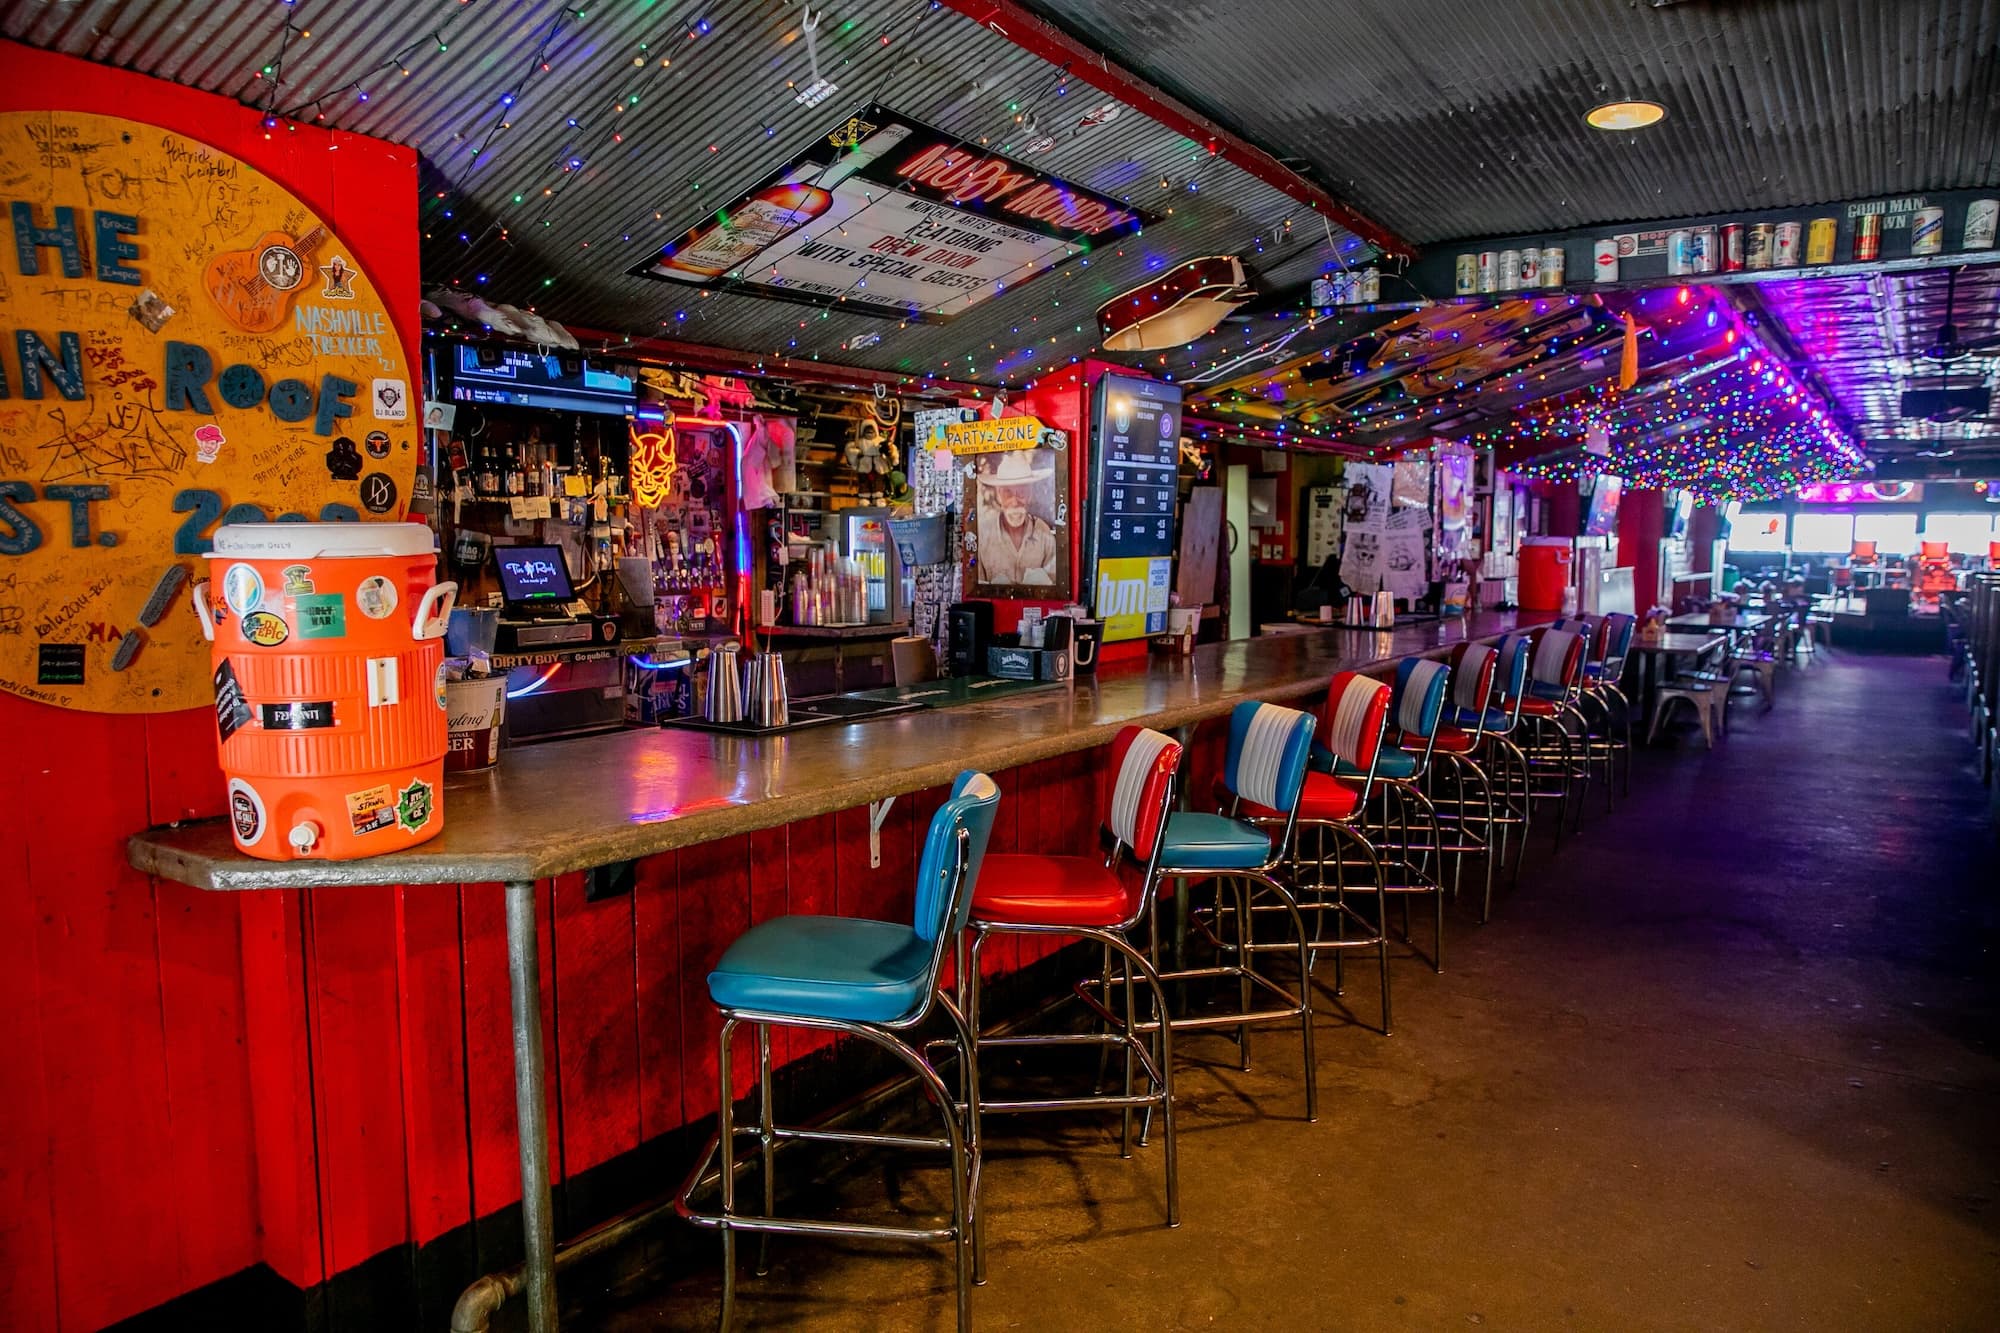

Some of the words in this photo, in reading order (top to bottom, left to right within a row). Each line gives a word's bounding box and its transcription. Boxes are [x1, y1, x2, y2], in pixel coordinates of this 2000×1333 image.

[1003, 182, 1138, 236] MONDAY
[1847, 202, 1886, 218] GOOD
[1889, 197, 1924, 214] MAN
[904, 199, 958, 221] MONTHLY
[955, 214, 998, 231] ARTIST
[991, 225, 1046, 245] SHOWCASE
[904, 219, 1003, 254] FEATURING
[867, 234, 930, 259] DREW
[921, 248, 983, 270] DIXON
[797, 241, 857, 264] WITH
[848, 253, 926, 281] SPECIAL
[920, 269, 989, 291] GUESTS
[764, 275, 799, 288] LAST
[801, 281, 846, 296] MONDAY
[293, 304, 387, 336] NASHVILLE
[305, 332, 384, 358] TREKKERS
[165, 339, 358, 438] ROOF
[375, 408, 384, 417] DJ
[384, 408, 406, 417] BLANCO
[947, 429, 986, 447] PARTY
[996, 423, 1036, 442] ZONE
[281, 445, 306, 465] TRIBE
[505, 562, 525, 576] Tin
[534, 560, 557, 576] Roof
[256, 626, 285, 642] EPIC
[262, 619, 280, 631] DJ
[690, 622, 705, 630] YETI
[492, 654, 534, 669] DIRTY
[535, 653, 561, 666] BOY
[574, 653, 587, 663] Go
[586, 650, 611, 664] public
